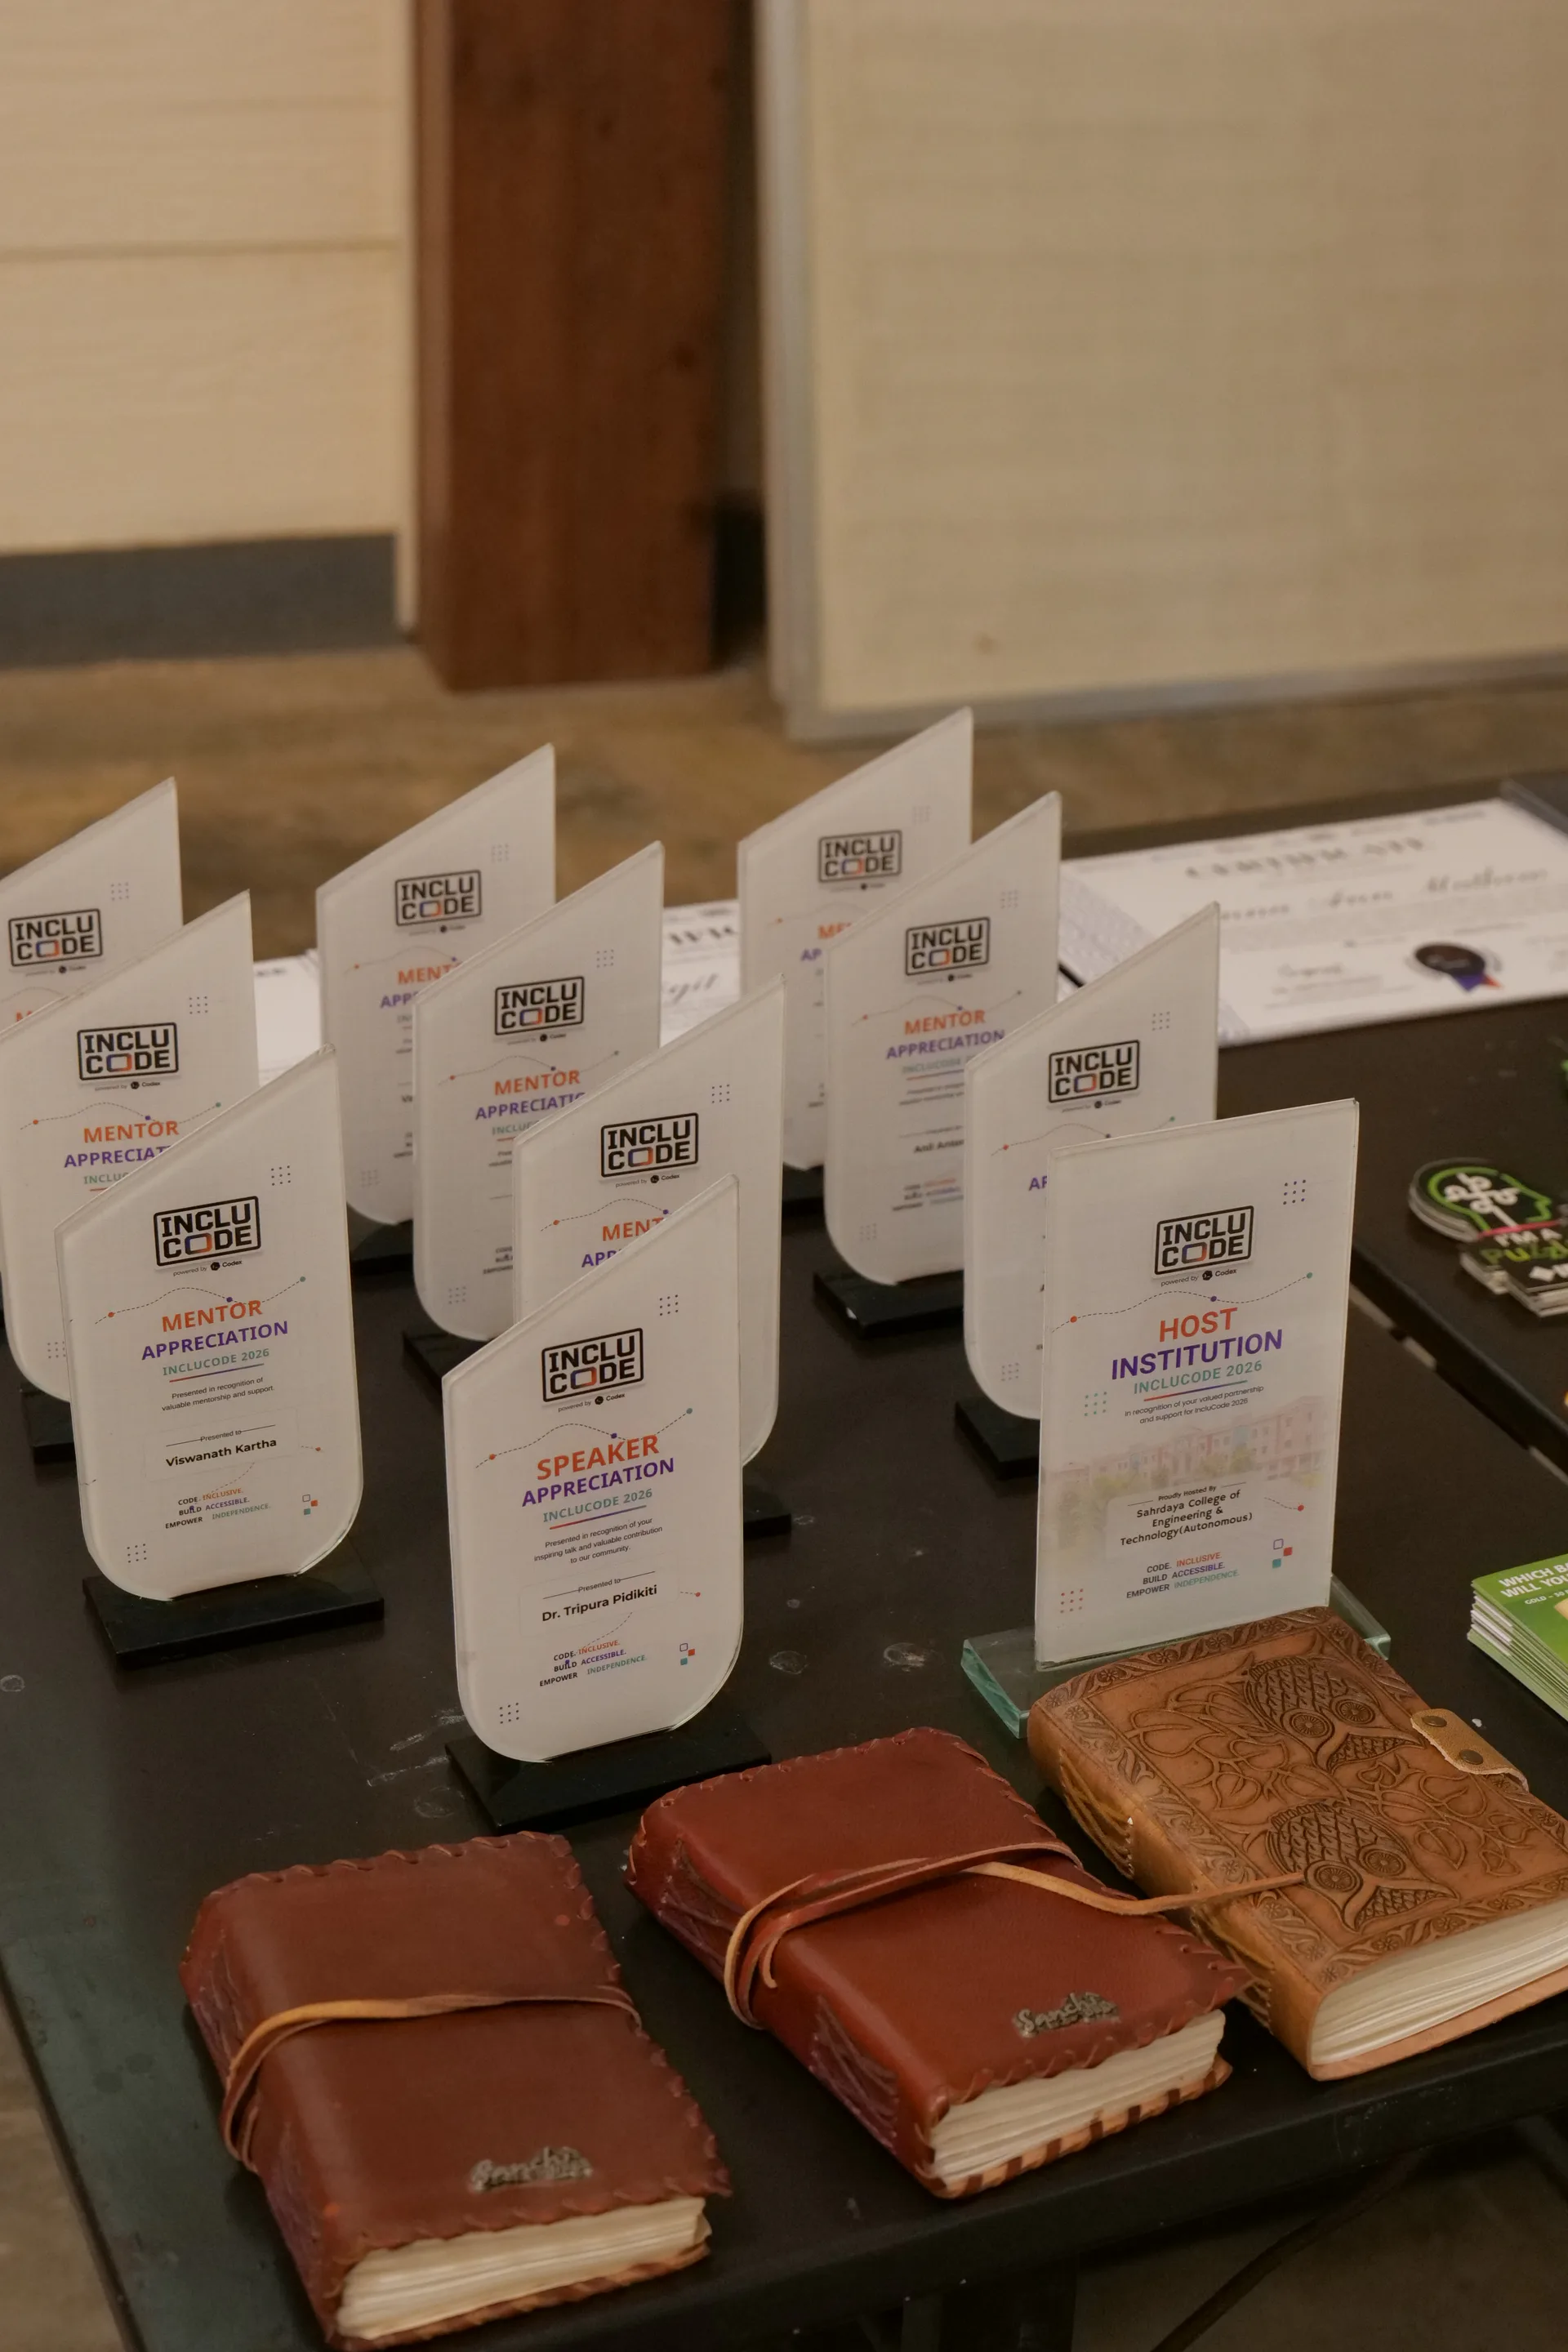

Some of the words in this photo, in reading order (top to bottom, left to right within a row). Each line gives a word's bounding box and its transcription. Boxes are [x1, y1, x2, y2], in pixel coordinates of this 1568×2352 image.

[825, 836, 894, 858] INCLU
[825, 855, 893, 876] CODE
[401, 876, 473, 901] INCLU
[403, 896, 474, 920] CODE
[16, 915, 93, 941] INCLU
[911, 923, 982, 950] INCLU
[17, 934, 95, 960] CODE
[911, 943, 982, 969] CODE
[501, 982, 577, 1009] INCLU
[501, 1002, 577, 1028] CODE
[904, 1009, 985, 1036] MENTOR
[85, 1029, 169, 1054] INCLU
[886, 1030, 1005, 1059] APPRECIATION
[86, 1049, 171, 1074] CODE
[1055, 1046, 1133, 1076] INCLU
[495, 1070, 580, 1095] MENTOR
[1055, 1067, 1132, 1096] CODE
[84, 1120, 179, 1143] MENTOR
[608, 1120, 690, 1150] INCLU
[608, 1141, 690, 1170] CODE
[161, 1203, 251, 1237] INCLU
[1163, 1213, 1245, 1246] INCLU
[163, 1225, 252, 1259] CODE
[1161, 1234, 1245, 1267] CODE
[173, 1267, 198, 1277] powered
[222, 1259, 243, 1267] Codex
[1160, 1276, 1189, 1287] powered
[1191, 1275, 1198, 1283] by
[1215, 1268, 1236, 1277] Codex
[162, 1299, 263, 1332] MENTOR
[1159, 1307, 1238, 1343] HOST
[141, 1321, 288, 1360] APPRECIATION
[163, 1352, 237, 1375] INCLUCODE
[241, 1348, 270, 1361] 2026
[549, 1335, 635, 1373] INCLU
[1111, 1329, 1282, 1380] INSTITUTION
[172, 1387, 207, 1399] Presented
[217, 1379, 255, 1392] recognition
[550, 1357, 635, 1395] CODE
[1134, 1367, 1221, 1394] INCLUCODE
[1227, 1360, 1263, 1377] 2026
[162, 1401, 191, 1411] valuable
[193, 1393, 231, 1405] mentorship
[233, 1390, 246, 1398] and
[558, 1401, 583, 1413] powered
[585, 1399, 591, 1407] by
[606, 1393, 625, 1401] Codex
[1133, 1401, 1173, 1416] recognition
[1182, 1397, 1197, 1408] your
[1199, 1392, 1223, 1403] valued
[1224, 1386, 1264, 1400] partnership
[1140, 1415, 1154, 1423] and
[1156, 1410, 1182, 1422] support
[1184, 1407, 1193, 1415] for
[1195, 1401, 1230, 1413] IncluCode
[1232, 1397, 1248, 1406] 2026
[200, 1431, 234, 1442] Presented
[166, 1447, 232, 1467] Viswanath
[235, 1439, 277, 1454] Kartha
[537, 1434, 660, 1481] SPEAKER
[203, 1488, 243, 1501] INCLUSIVE.
[522, 1458, 674, 1507] APPRECIATION
[1158, 1490, 1182, 1502] Proudly
[1183, 1486, 1207, 1496] Hosted
[1209, 1485, 1217, 1493] By
[206, 1497, 250, 1511] ACCESSIBLE.
[543, 1496, 619, 1522] INCLUCODE
[623, 1488, 653, 1504] 2026
[1137, 1501, 1184, 1518] Sahrdaya
[1189, 1493, 1227, 1508] College
[1230, 1490, 1241, 1499] of
[1152, 1509, 1213, 1528] Engineering
[1216, 1506, 1223, 1514] &
[165, 1517, 203, 1529] EMPOWER
[545, 1534, 581, 1548] Presented
[590, 1524, 628, 1538] recognition
[638, 1518, 653, 1528] your
[1120, 1512, 1253, 1546] Technology(Autonomous)
[534, 1549, 563, 1561] inspiring
[565, 1545, 577, 1553] talk
[579, 1542, 592, 1551] and
[593, 1535, 622, 1548] valuable
[623, 1526, 663, 1540] contribution
[592, 1545, 631, 1559] community.
[1143, 1574, 1168, 1584] BUILD
[1172, 1561, 1226, 1579] ACCESSIBLE.
[1147, 1562, 1172, 1574] CODE.
[1176, 1552, 1223, 1567] INCLUSIVE.
[578, 1579, 612, 1593] Presented
[1499, 1568, 1554, 1587] WHICH
[1500, 1583, 1542, 1597] WILL
[542, 1609, 561, 1622] Dr.
[564, 1597, 609, 1616] Tripura
[612, 1584, 657, 1605] Pidikiti
[1126, 1584, 1169, 1599] EMPOWER
[1525, 1596, 1547, 1604] GOLD
[554, 1650, 576, 1661] CODE.
[578, 1639, 621, 1655] INCLUSIVE.
[554, 1660, 577, 1673] BUILD
[581, 1649, 627, 1665] ACCESSIBLE.
[540, 1672, 578, 1686] EMPOWER
